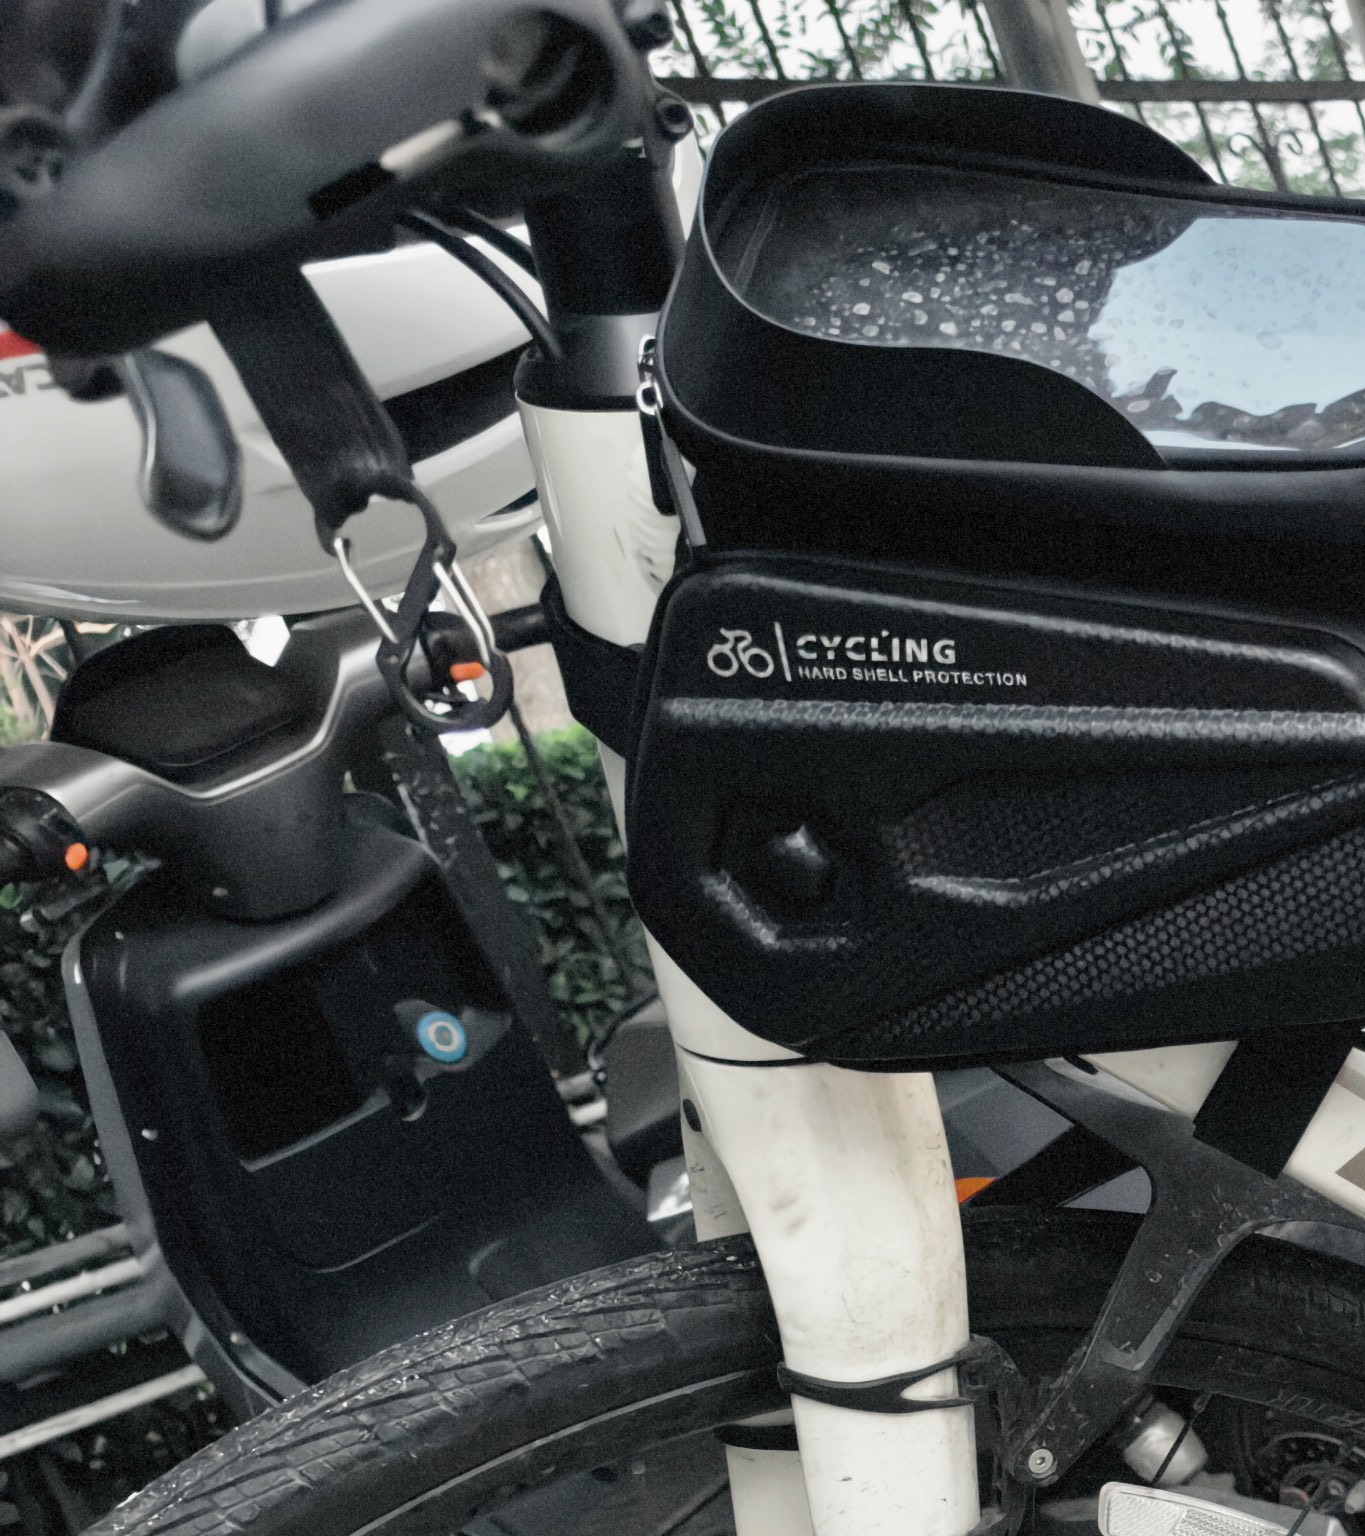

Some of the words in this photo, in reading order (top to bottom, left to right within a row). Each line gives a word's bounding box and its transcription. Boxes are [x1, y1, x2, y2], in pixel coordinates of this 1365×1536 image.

[796, 629, 957, 665] CYCLING
[799, 666, 848, 680] HARD
[853, 667, 909, 683] SHELL
[913, 669, 1028, 687] PROTECTION
